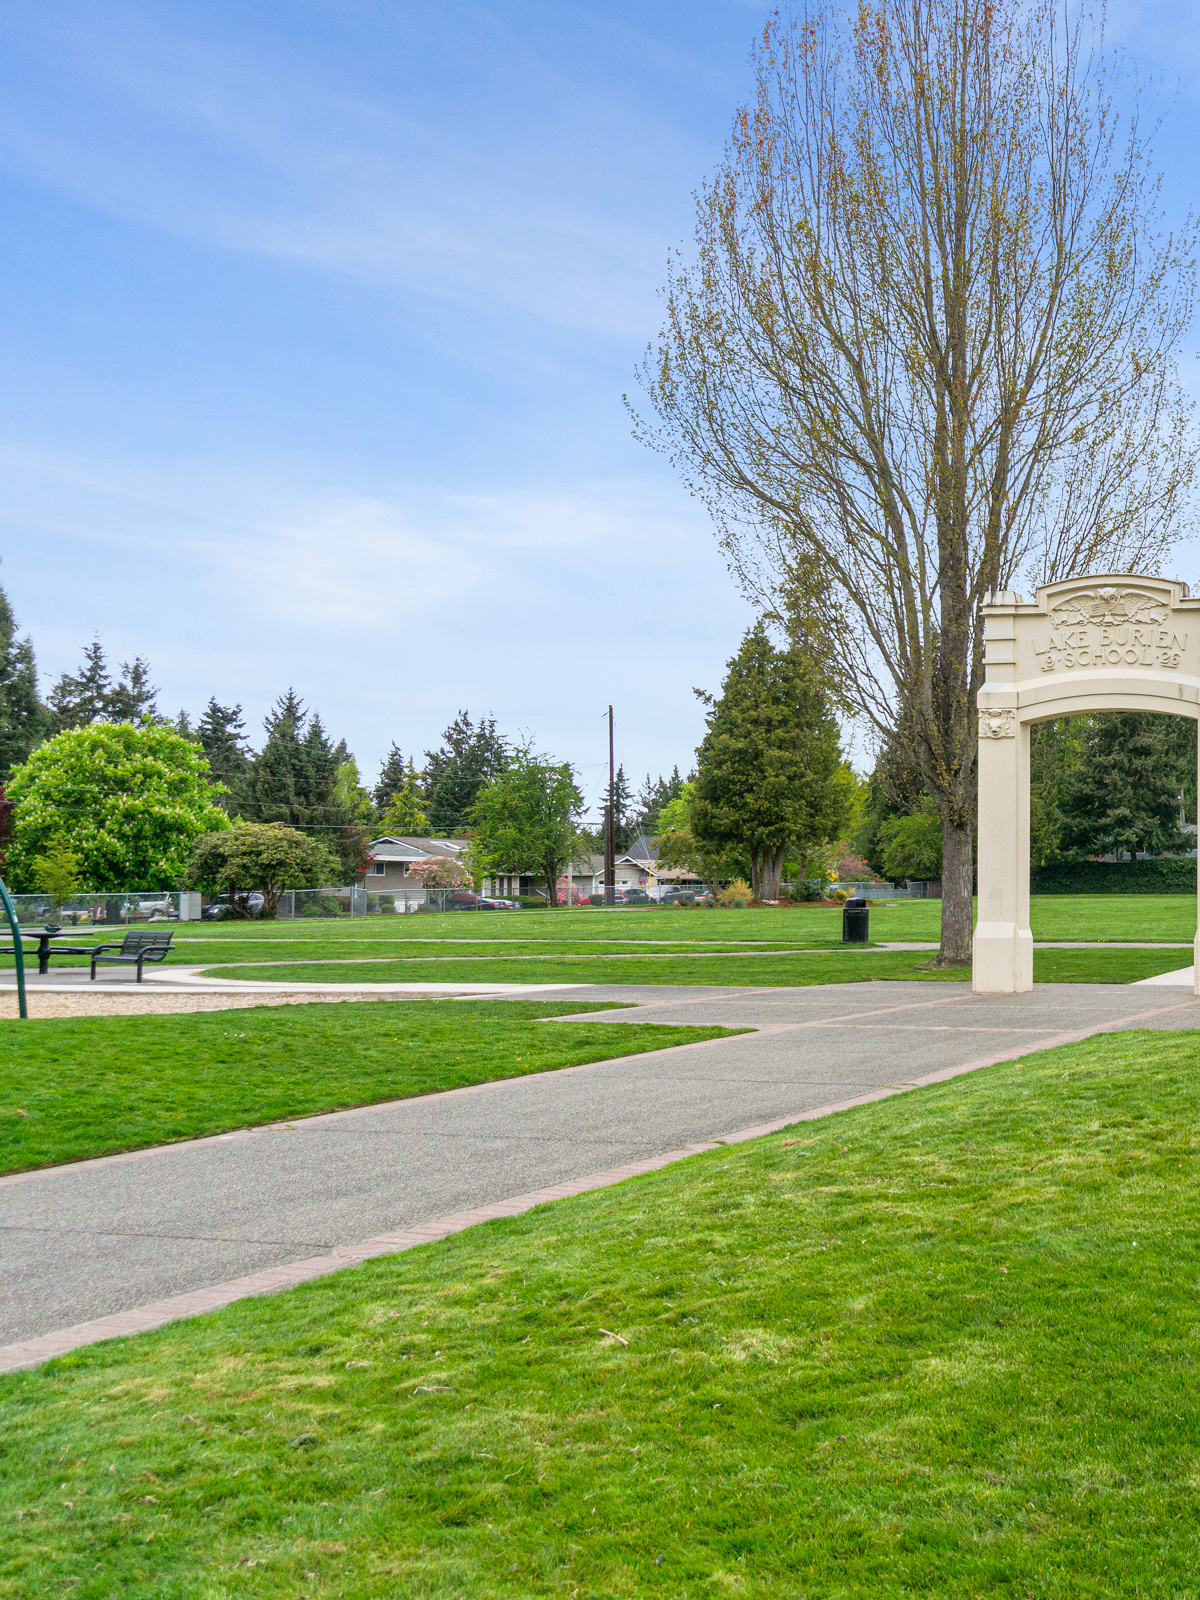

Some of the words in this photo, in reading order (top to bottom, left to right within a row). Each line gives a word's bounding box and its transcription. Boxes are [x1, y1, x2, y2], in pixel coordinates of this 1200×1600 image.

[1032, 630, 1090, 655] LAKE
[1100, 628, 1188, 651] BURIEN
[1064, 649, 1153, 668] SCHOOL
